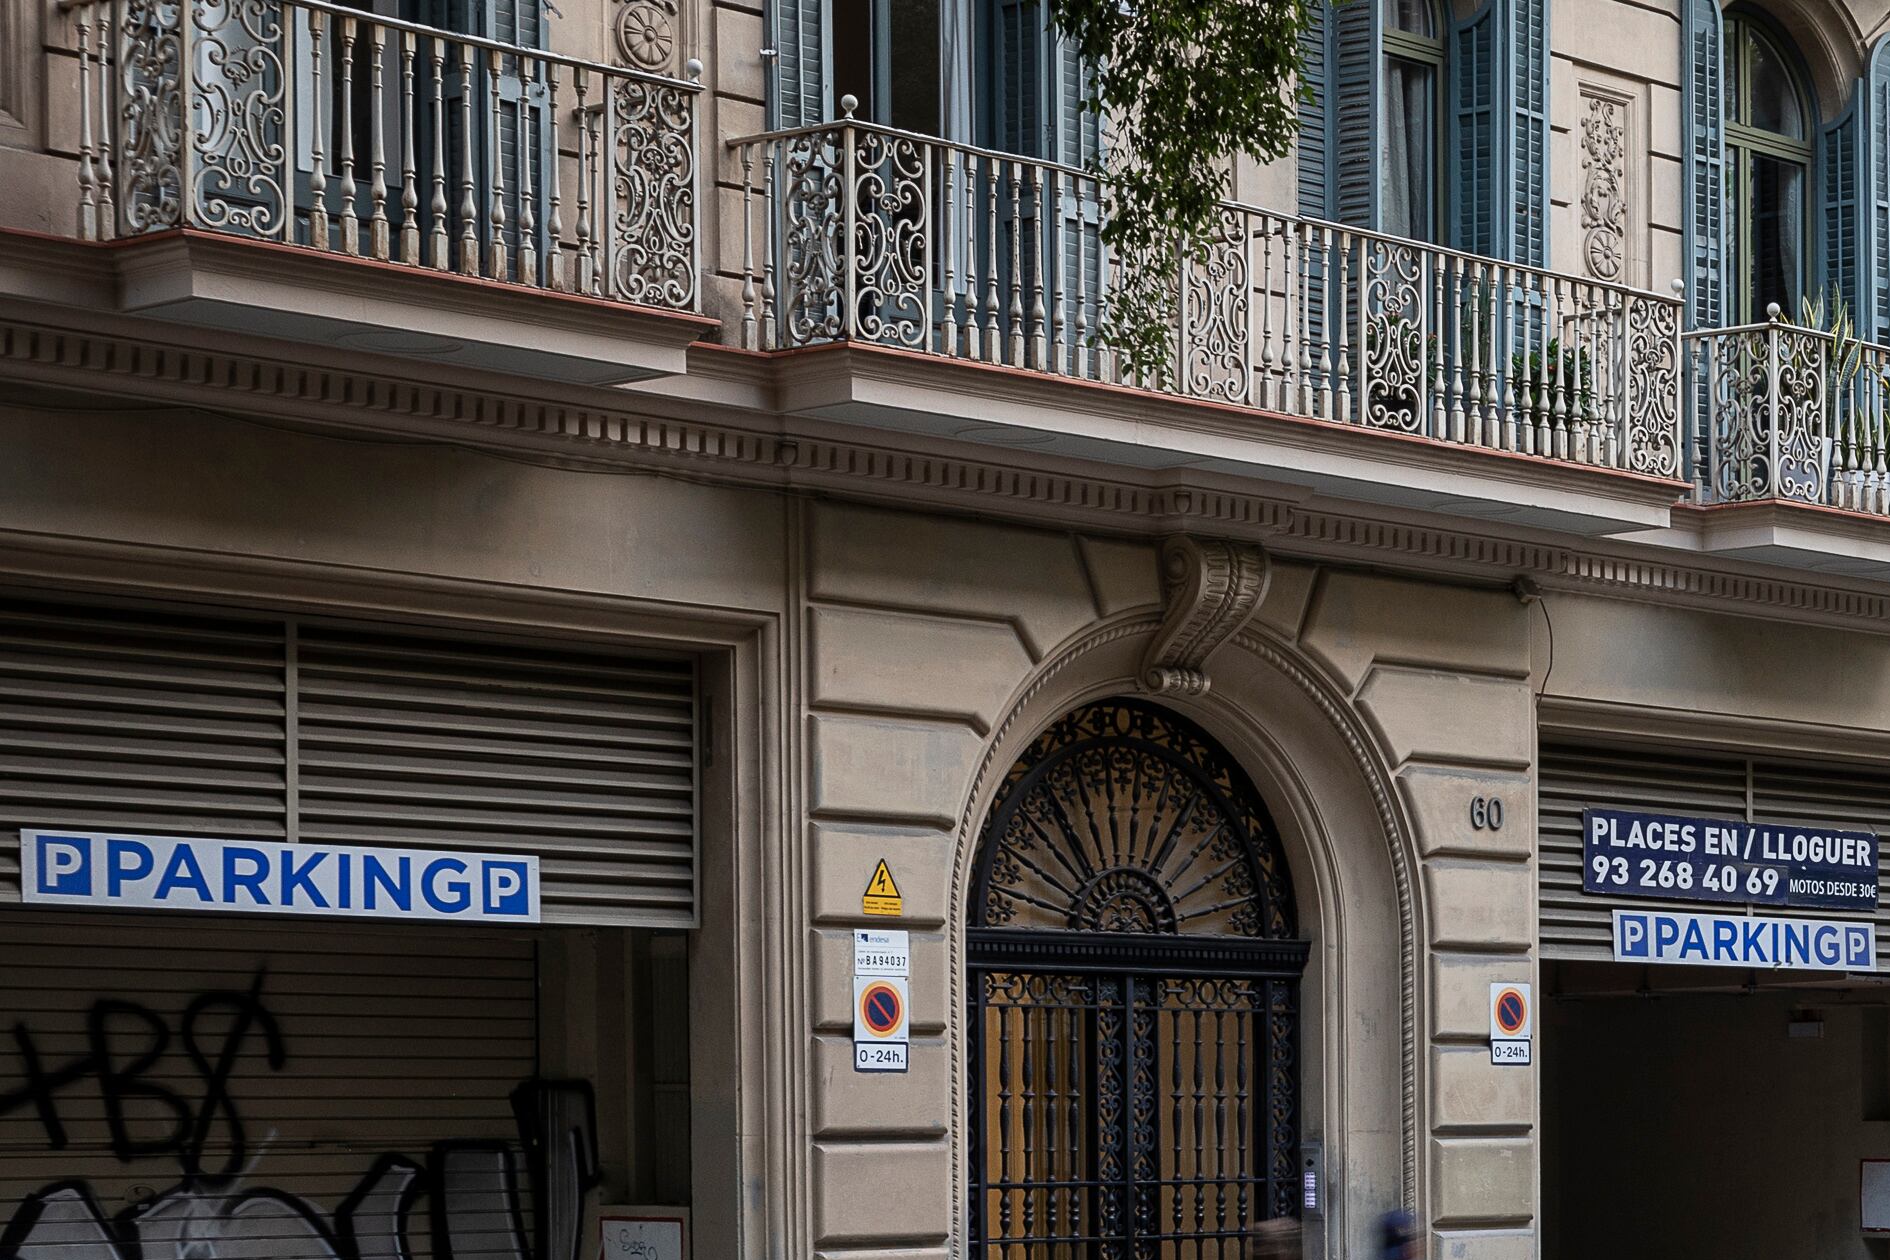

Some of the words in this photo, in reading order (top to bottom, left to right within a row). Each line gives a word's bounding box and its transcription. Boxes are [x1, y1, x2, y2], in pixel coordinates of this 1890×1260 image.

[1471, 796, 1504, 831] 60
[1591, 816, 1696, 852] PLACES
[1704, 825, 1738, 857] EN
[1762, 831, 1871, 867] LLOGUER
[106, 838, 471, 914] PARKING
[1592, 855, 1629, 885] 93
[1639, 859, 1694, 890] 268
[1702, 864, 1737, 893] 40
[1745, 867, 1779, 896] 69
[1789, 878, 1824, 896] MOTOS
[1826, 881, 1858, 897] DESDE
[1858, 882, 1876, 898] 30€
[1655, 916, 1841, 966] PARKING
